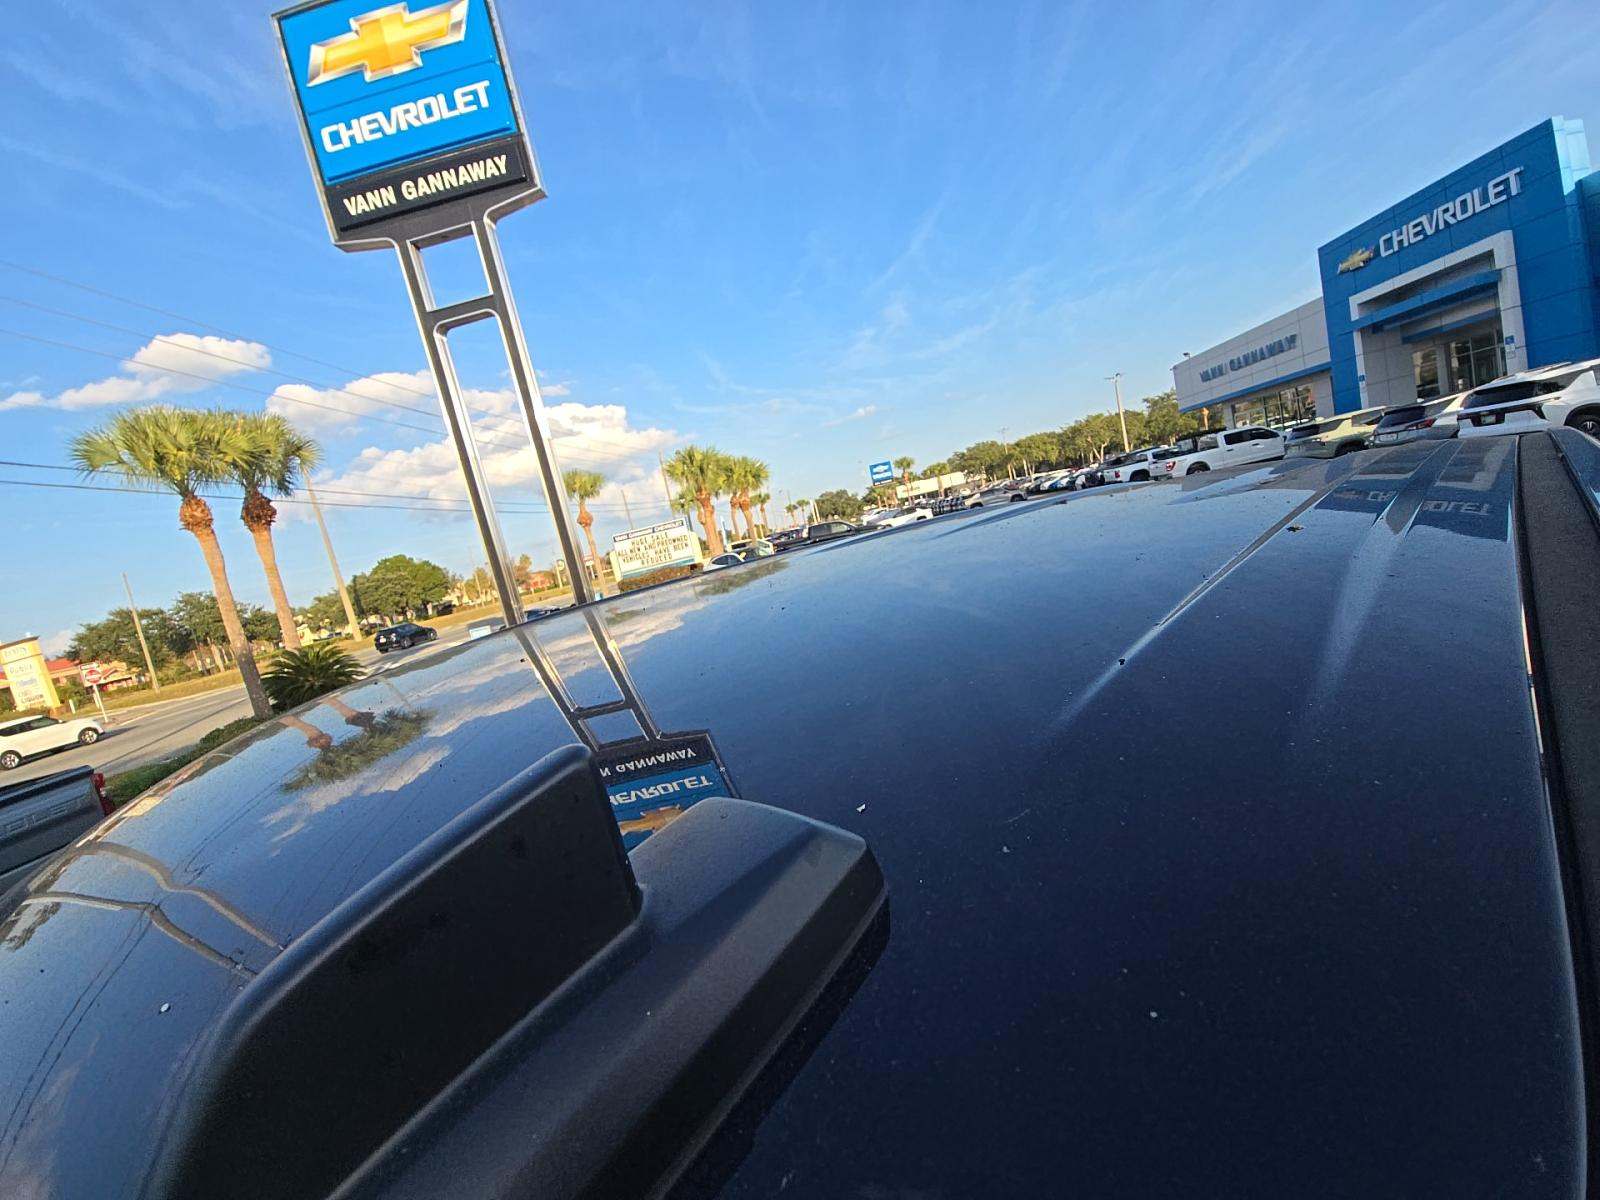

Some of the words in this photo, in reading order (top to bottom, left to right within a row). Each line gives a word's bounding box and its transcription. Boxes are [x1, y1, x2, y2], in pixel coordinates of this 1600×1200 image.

[320, 80, 490, 153] CHEVROLET
[343, 185, 397, 216] VANN
[401, 154, 508, 200] GANNAWAY
[1379, 167, 1523, 258] CHEVROLET
